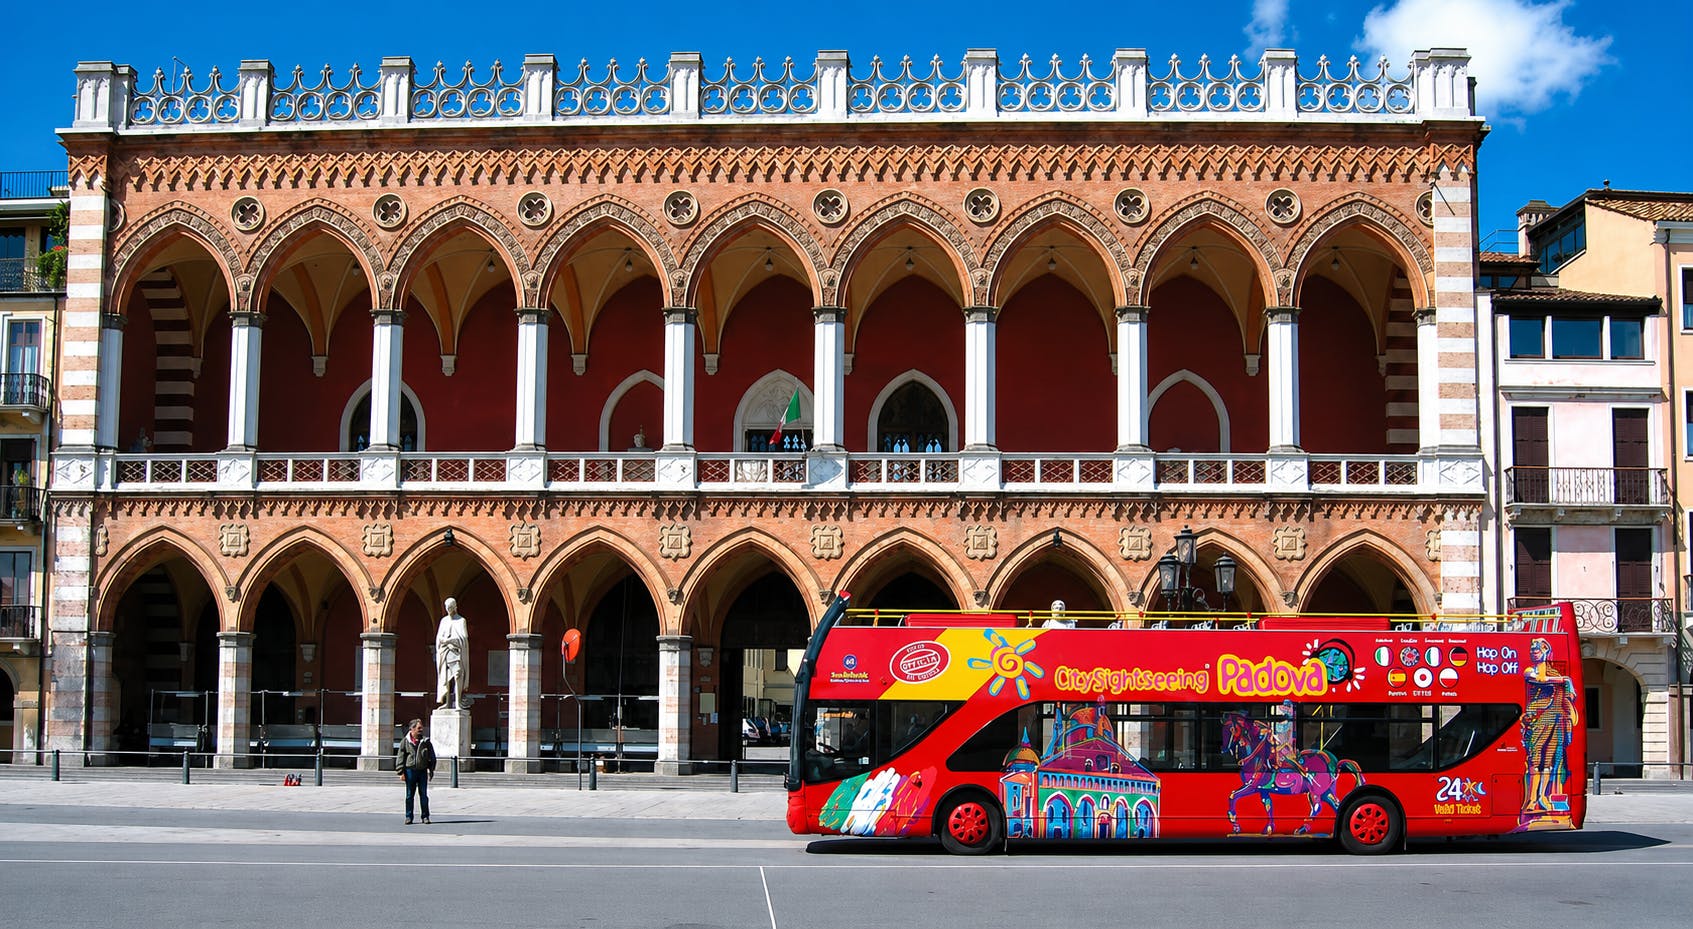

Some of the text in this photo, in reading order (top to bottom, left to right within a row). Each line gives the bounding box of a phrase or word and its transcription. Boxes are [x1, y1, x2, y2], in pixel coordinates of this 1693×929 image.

[1476, 646, 1517, 660] Hop On
[1054, 667, 1209, 695] CitySightseeing
[1217, 653, 1328, 697] Padova
[1476, 661, 1519, 675] Hop Off
[1436, 776, 1463, 802] 24
